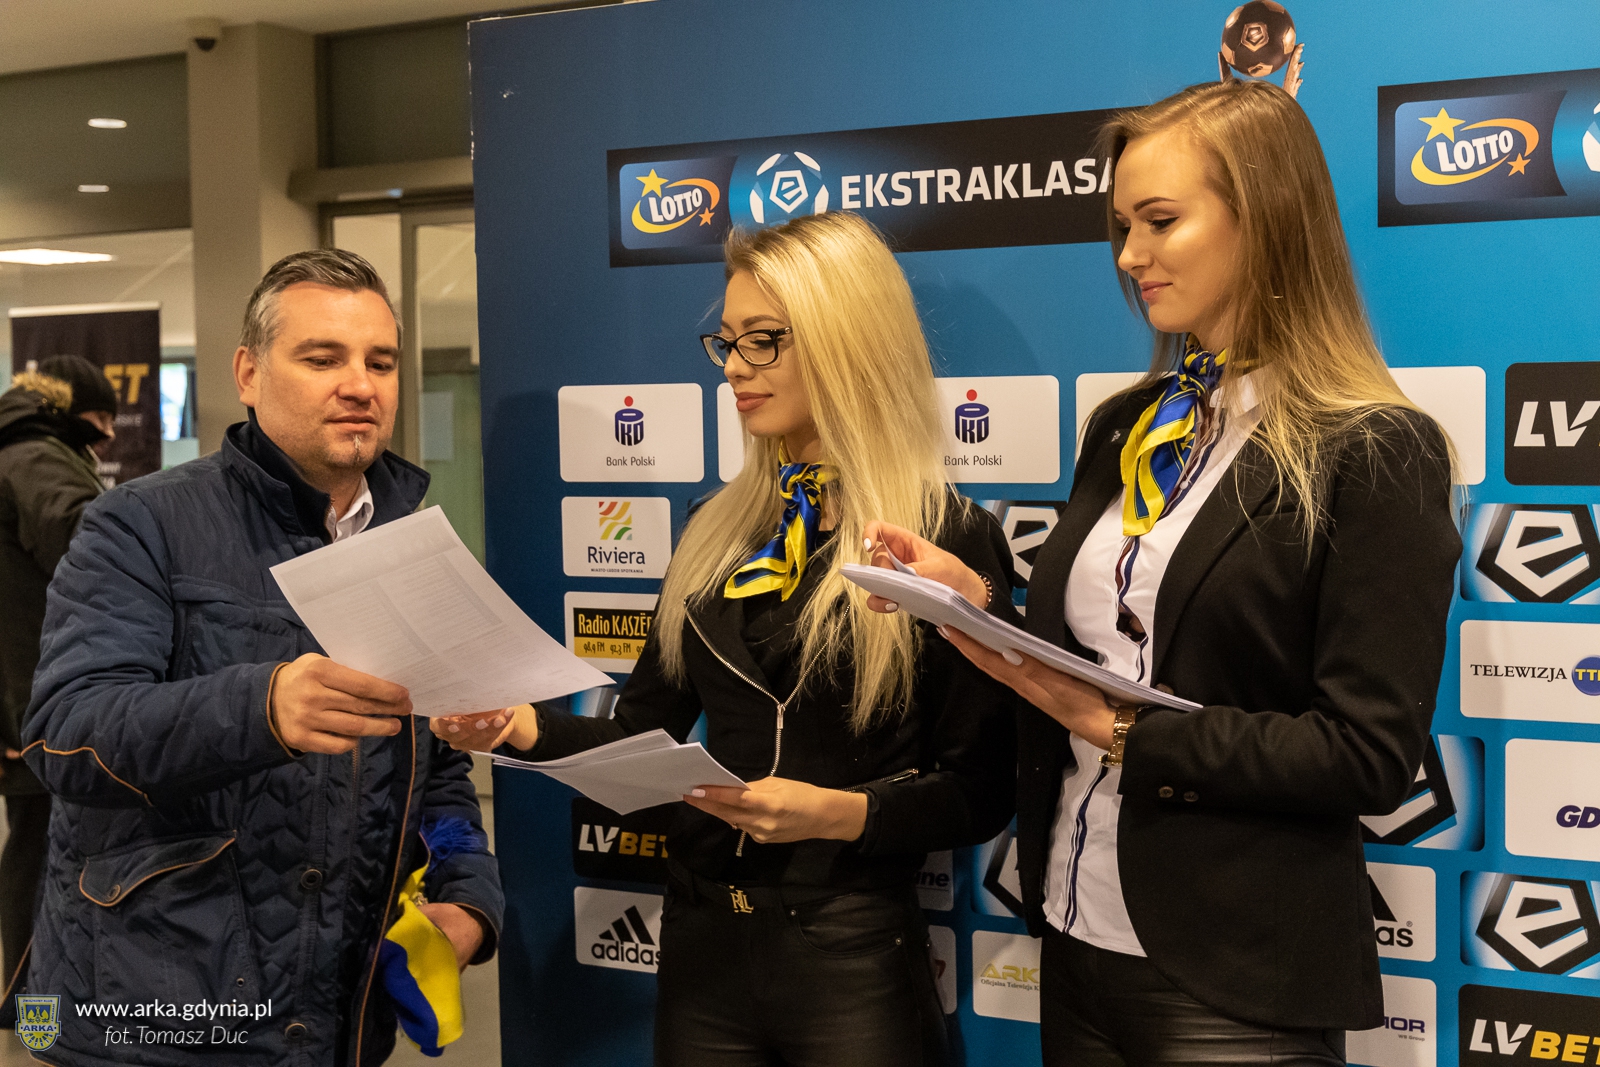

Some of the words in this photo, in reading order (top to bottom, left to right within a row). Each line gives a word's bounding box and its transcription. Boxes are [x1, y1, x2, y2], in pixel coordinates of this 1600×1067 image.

[1436, 130, 1514, 172] LOTTO
[648, 187, 703, 223] LOTTO
[606, 456, 628, 467] Bank
[630, 456, 656, 467] Polski
[944, 454, 970, 466] Bank
[973, 454, 1002, 466] Polski
[587, 546, 646, 565] Riviera
[578, 613, 610, 636] Radio
[597, 642, 606, 652] FM
[623, 643, 632, 653] FM
[1470, 664, 1567, 683] TELEWIZJA
[1575, 668, 1600, 682] TT
[1469, 1018, 1600, 1065] LVBE
